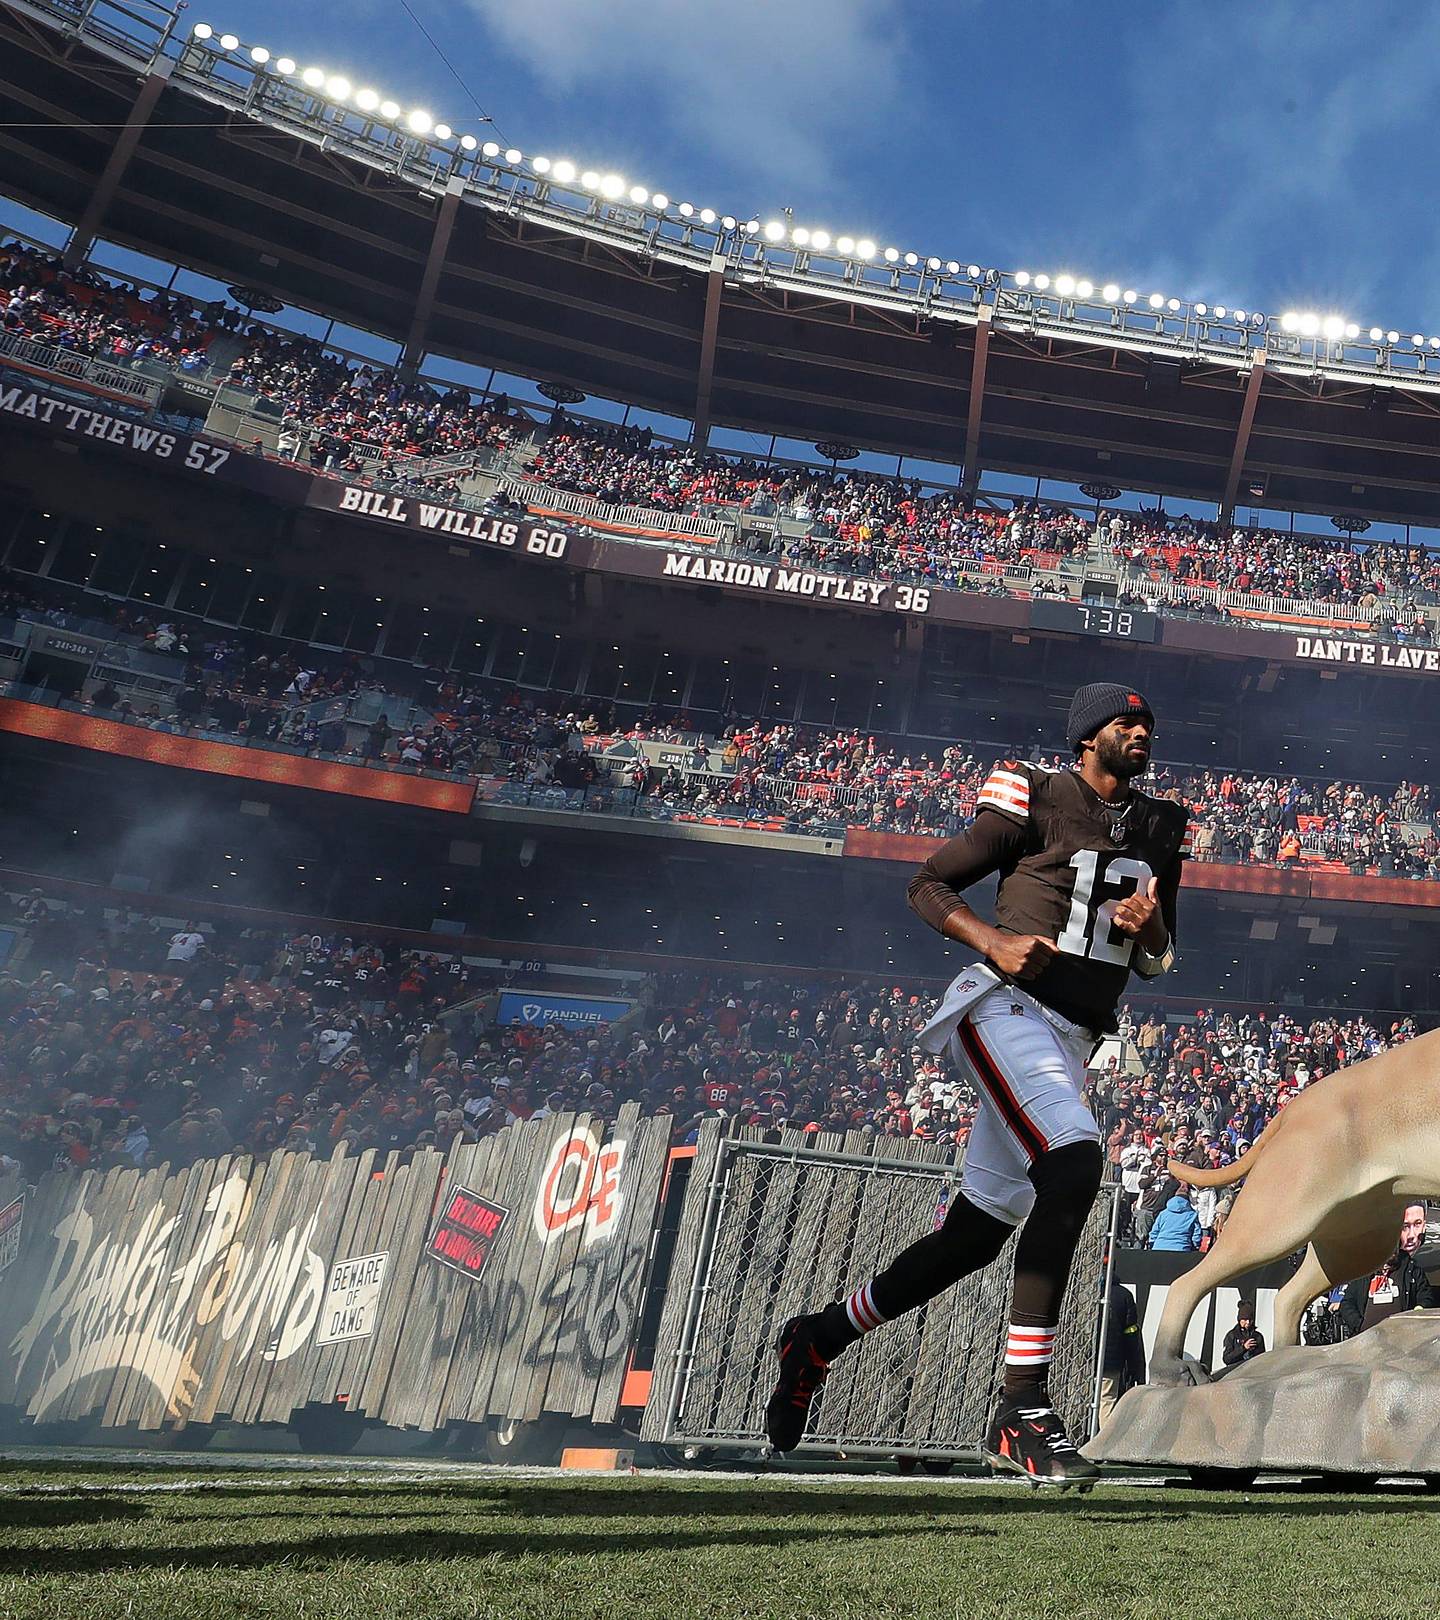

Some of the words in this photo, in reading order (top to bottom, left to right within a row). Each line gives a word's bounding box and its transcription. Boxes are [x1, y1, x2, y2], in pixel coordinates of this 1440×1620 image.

[0, 384, 176, 458] MATTHEWS
[185, 440, 231, 475] 57
[340, 487, 407, 522] BILL
[420, 503, 518, 547] WILLIS
[526, 527, 568, 559] 60
[663, 553, 772, 588] MARION
[775, 569, 887, 605] MOTLEY
[895, 586, 930, 613] 36
[1077, 607, 1133, 636] 7:38
[1296, 637, 1375, 665] DANTE
[1062, 849, 1153, 967] 12
[710, 1088, 728, 1102] 88
[447, 1195, 502, 1239] BEWARE
[168, 1167, 326, 1368] POUND
[332, 1258, 384, 1293] BEWARE
[345, 1289, 360, 1307] OF
[329, 1306, 365, 1337] DAWG
